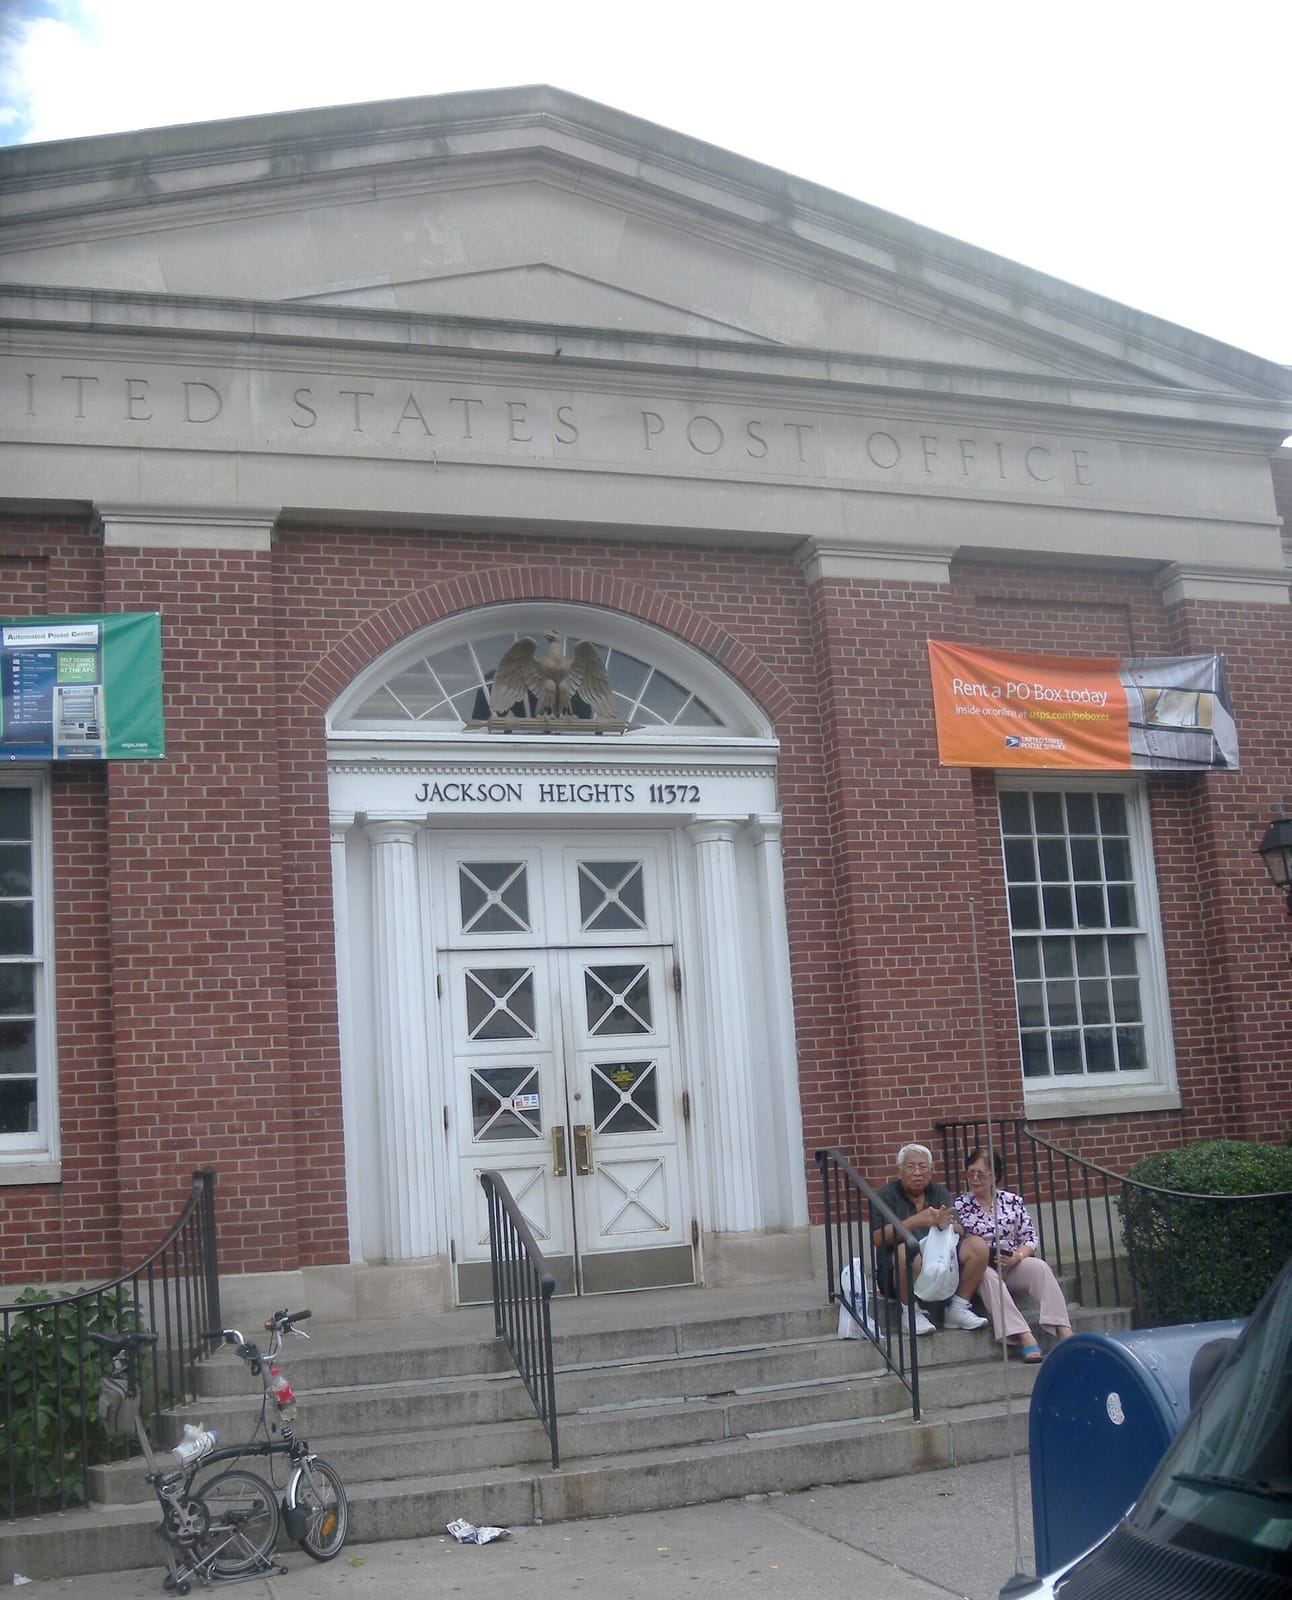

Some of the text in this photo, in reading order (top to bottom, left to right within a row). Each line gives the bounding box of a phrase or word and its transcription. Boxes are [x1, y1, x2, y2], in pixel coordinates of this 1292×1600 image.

[290, 387, 580, 445] STATES
[640, 410, 813, 463] POST
[866, 430, 1096, 487] OFFICE
[7, 633, 46, 641] Automated
[952, 678, 1107, 707] Rent a PO Box today
[982, 707, 991, 716] or
[992, 705, 1017, 718] online
[1018, 708, 1027, 718] at
[1029, 711, 1109, 723] usps.com/poboxes
[1021, 735, 1064, 745] UNITED STATES
[1043, 743, 1065, 751] SERVICE
[415, 782, 701, 805] JACKSON HEIGHTS 11372
